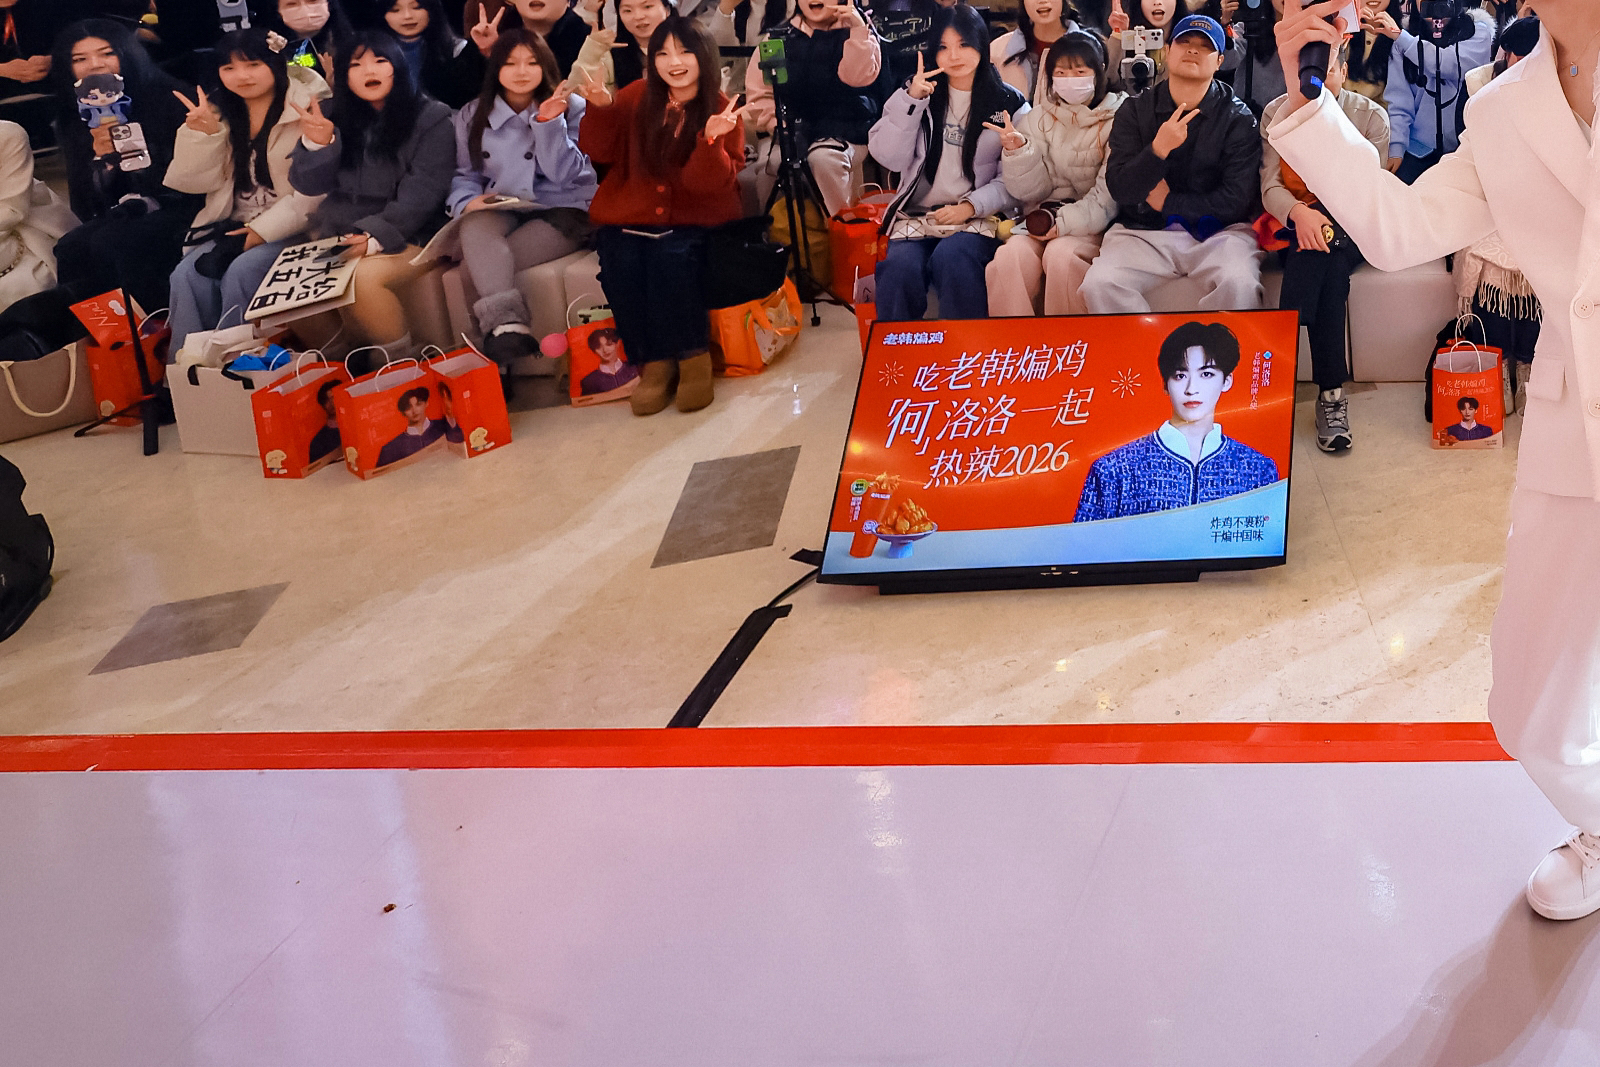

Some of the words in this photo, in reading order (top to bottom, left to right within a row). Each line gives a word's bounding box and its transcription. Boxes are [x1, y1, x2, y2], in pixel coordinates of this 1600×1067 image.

[883, 332, 944, 345] 老韩煸鸡
[912, 339, 1089, 392] 吃老韩煸鸡
[1261, 361, 1271, 386] 何洛洛
[922, 439, 1074, 490] 热辣2026
[1210, 515, 1265, 530] 炸鸡不裹粉
[1211, 529, 1264, 543] 干煸中国味
